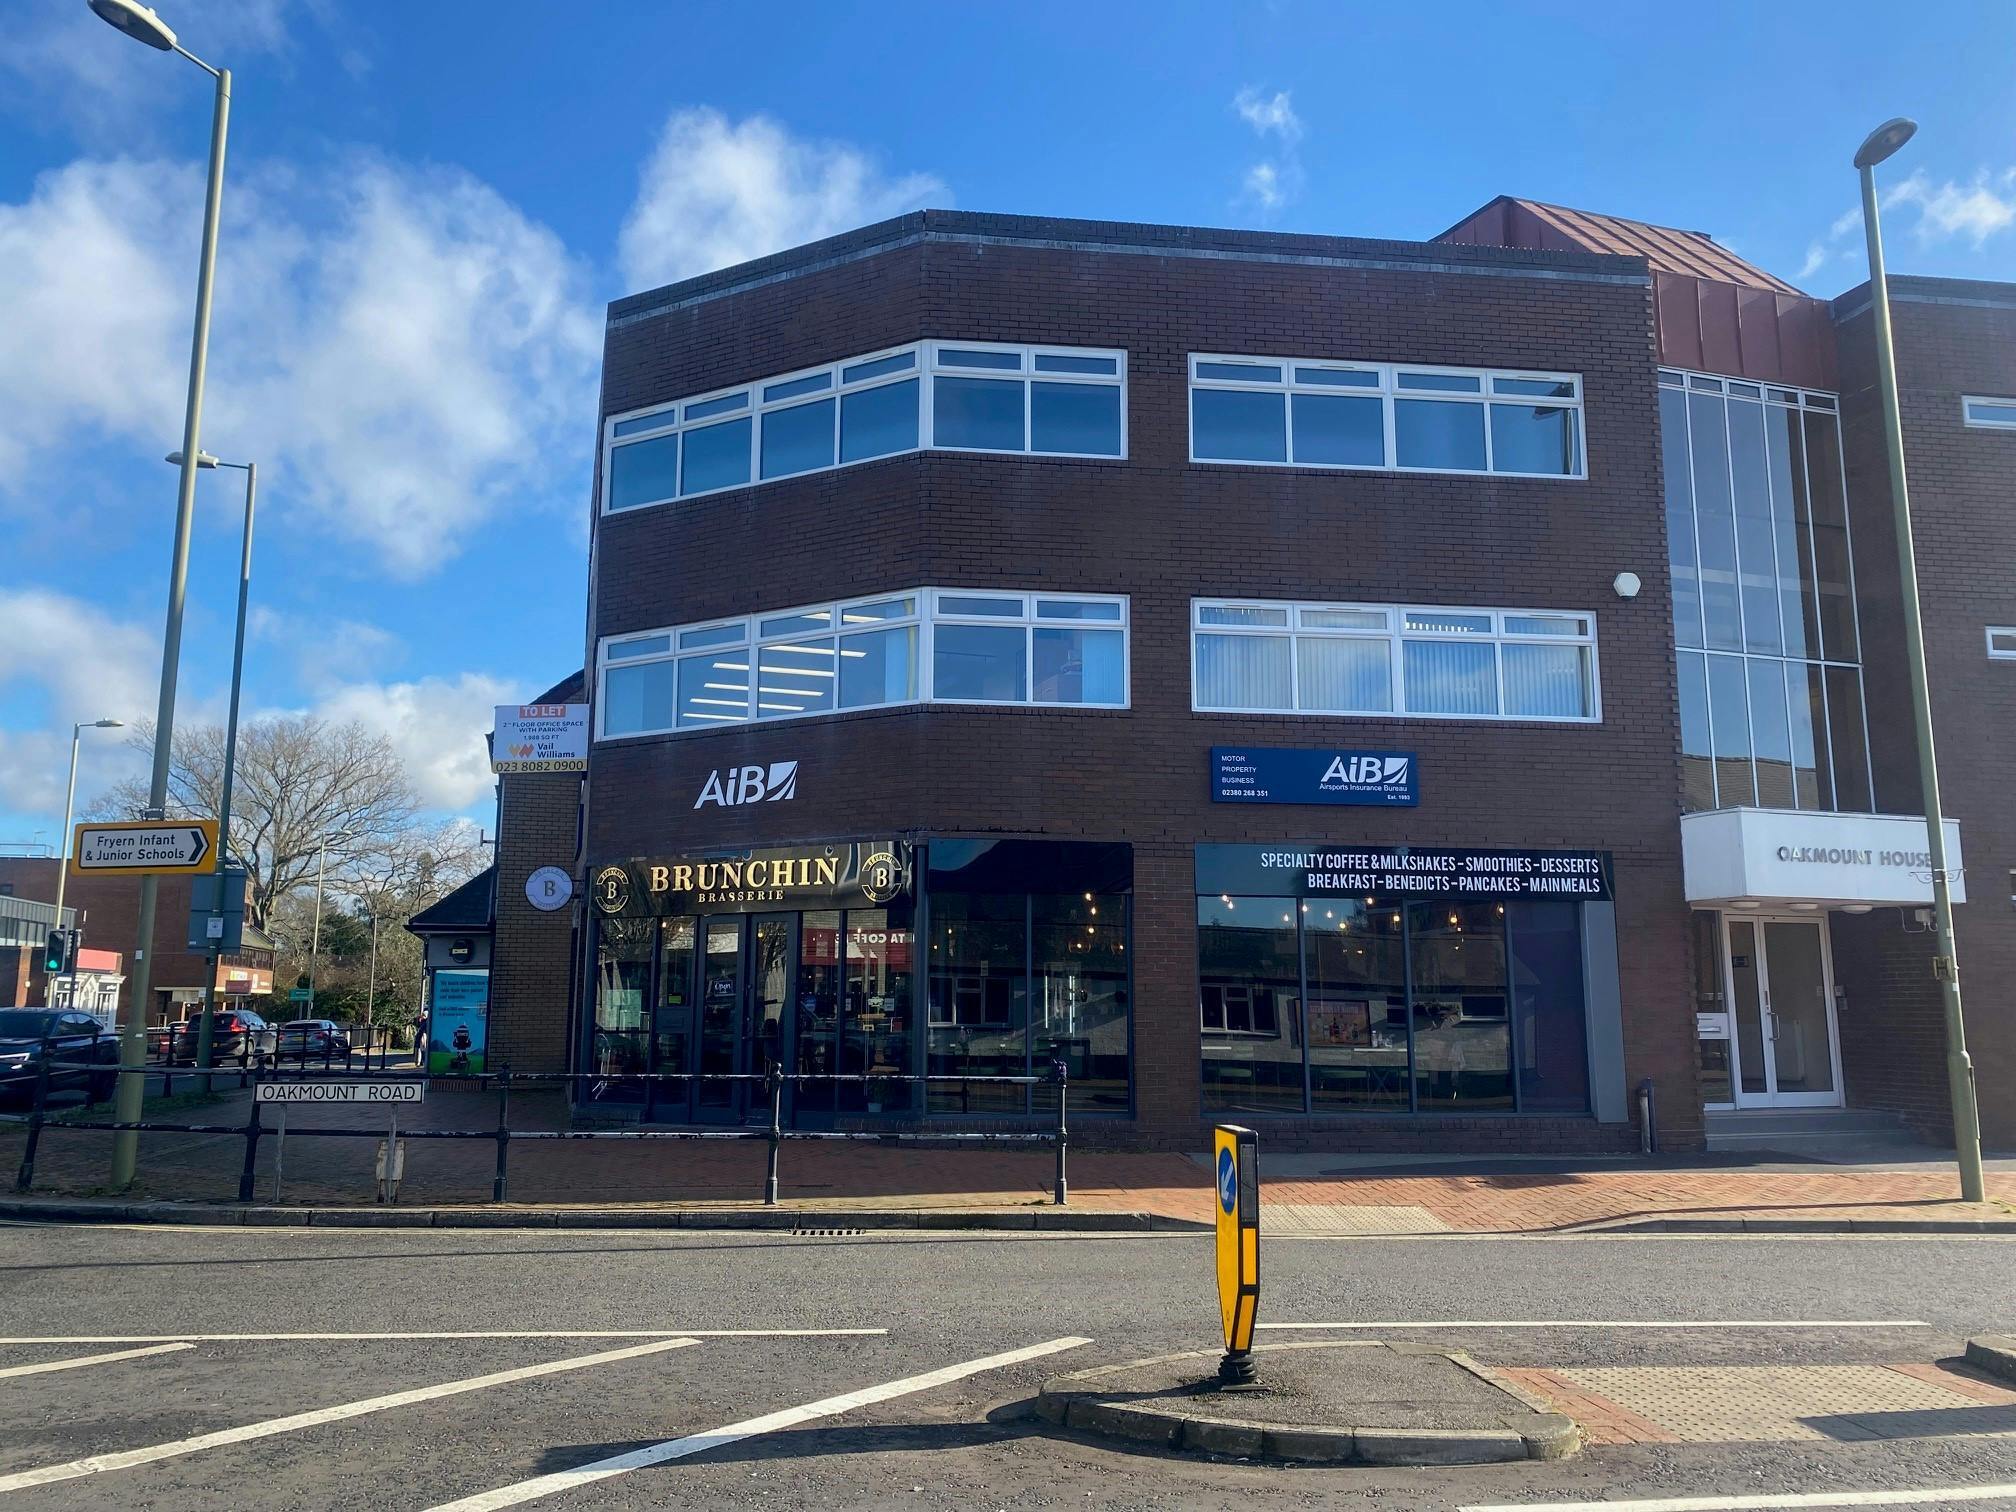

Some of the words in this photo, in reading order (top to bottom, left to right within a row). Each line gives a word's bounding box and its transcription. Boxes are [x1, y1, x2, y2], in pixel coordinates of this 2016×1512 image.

[523, 706, 538, 716] TO
[542, 706, 564, 716] LET
[537, 743, 554, 751] Vail
[537, 751, 576, 759] Williams
[496, 762, 518, 772] 023
[521, 762, 551, 772] 8082
[553, 760, 584, 771] 0900
[1221, 765, 1257, 773] PROPERTY
[1320, 756, 1383, 783] AiB
[1221, 776, 1255, 784] BUSINESS
[1319, 783, 1349, 791] Airsports
[1349, 783, 1382, 791] Insurance
[692, 765, 766, 810] AiB
[97, 836, 135, 848] Fryern
[139, 834, 176, 846] Infant
[85, 850, 93, 861] &
[96, 849, 133, 860] Junior
[137, 848, 185, 860] Schools
[1777, 845, 1873, 866] OAKMOUNT
[1261, 852, 1324, 868] SPECIALTY
[1325, 853, 1369, 869] COFFEE
[1371, 854, 1380, 870] &
[1380, 855, 1456, 871] MILKSHAKES
[1466, 856, 1532, 872] SMOOTHIES
[1541, 858, 1599, 874] DESSERTS
[650, 857, 839, 892] BRUNCHIN
[876, 868, 888, 887] B
[544, 880, 556, 897] B
[1308, 873, 1377, 889] BREAKFAST
[1385, 874, 1450, 890] BENEDICTS
[1459, 876, 1520, 891] PANCAKES
[606, 881, 618, 899] B
[698, 889, 784, 903] BRASSERIE
[263, 1085, 359, 1100] OAKMOUNT
[368, 1085, 415, 1100] ROAD
